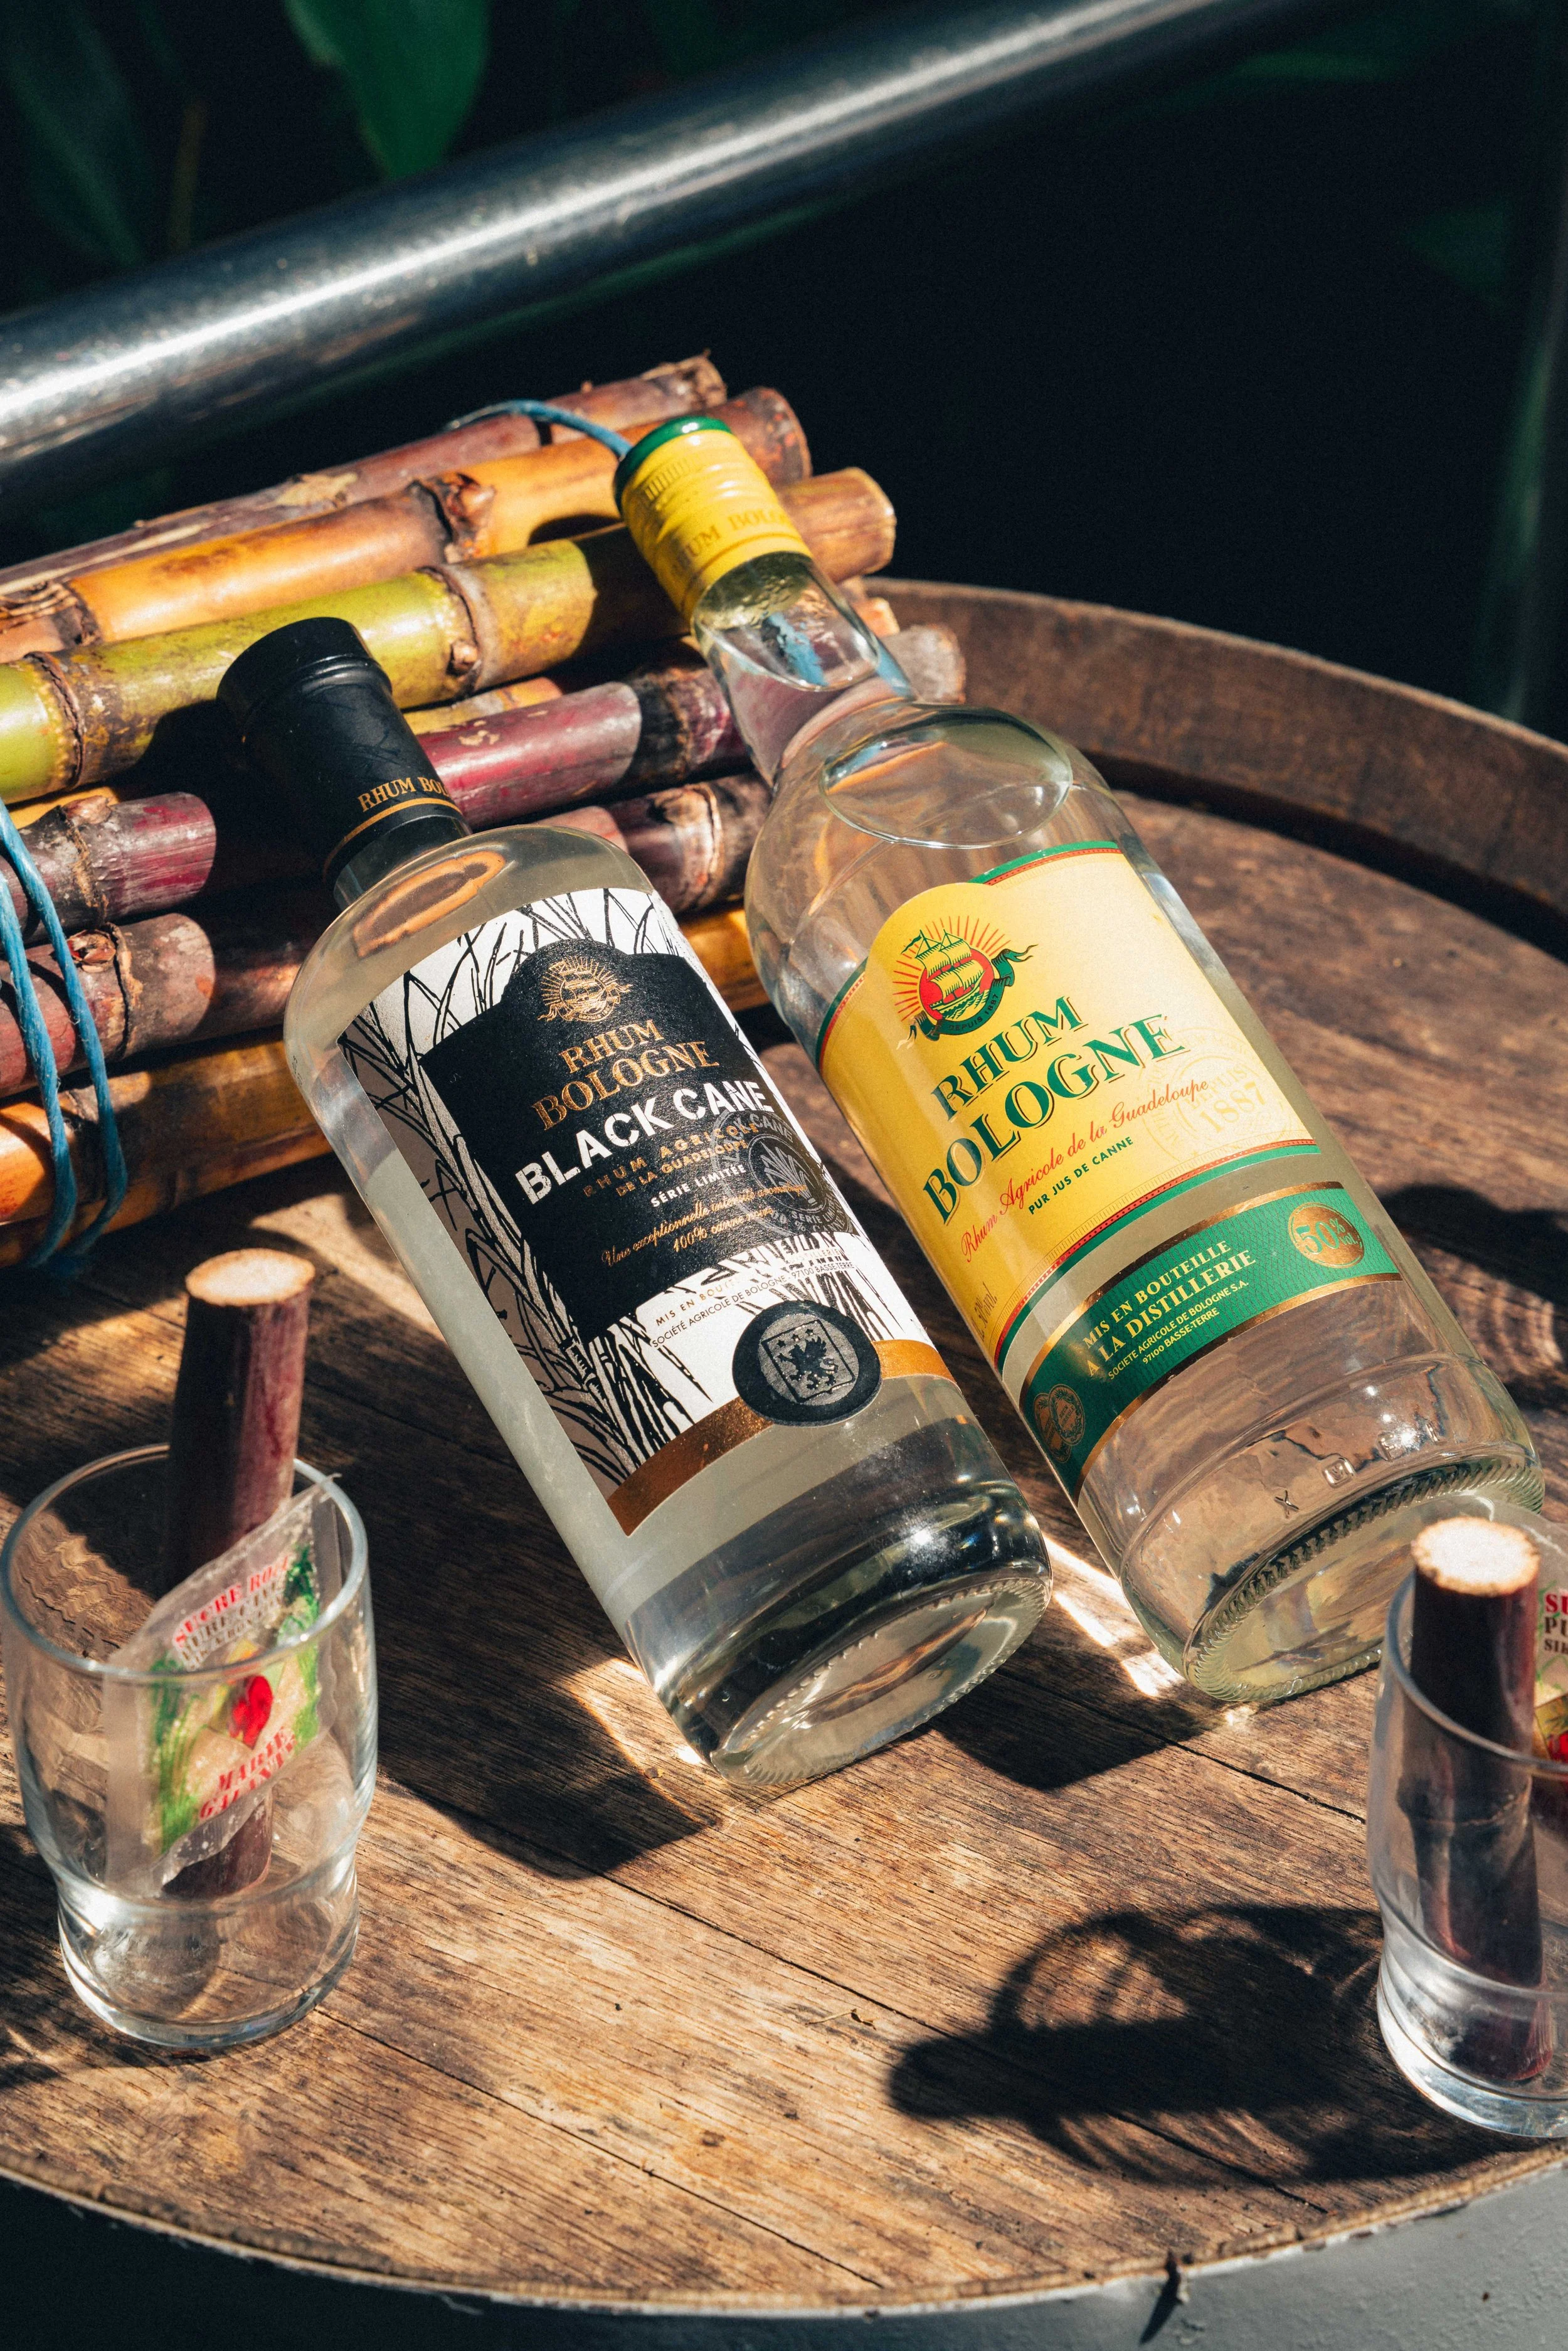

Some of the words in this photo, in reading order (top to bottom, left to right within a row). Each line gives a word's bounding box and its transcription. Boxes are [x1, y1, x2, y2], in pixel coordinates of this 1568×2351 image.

[358, 777, 416, 812] RHUM
[559, 1019, 665, 1074] RHUM
[948, 1016, 983, 1031] DEPUIS
[984, 993, 999, 1016] 1887
[532, 1040, 720, 1131] BOLOGNE
[931, 995, 1088, 1121] RHUM
[515, 1096, 675, 1205] BLACK
[673, 1080, 775, 1120] CANE
[922, 1014, 1190, 1224] BOLOGNE
[1199, 1080, 1266, 1133] 1887
[583, 1156, 647, 1197] RHUM
[660, 1122, 760, 1159] AGRICOLE
[616, 1181, 636, 1197] DE
[638, 1170, 659, 1186] LA
[661, 1139, 749, 1174] GUADELOUPE
[650, 1182, 691, 1207] SÉRIE
[695, 1164, 747, 1187] LIMITÉE
[960, 1214, 998, 1262] Rhum
[999, 1153, 1065, 1216] Agricole
[1066, 1134, 1087, 1159] de
[1088, 1120, 1108, 1144] la
[1110, 1078, 1209, 1130] Guadeloupe
[1027, 1193, 1050, 1216] PUR
[1052, 1175, 1073, 1196] JUS
[1074, 1162, 1091, 1180] DE
[1091, 1135, 1135, 1168] CANNE
[601, 1245, 631, 1267] Une
[672, 1225, 708, 1253] 100%
[652, 1321, 688, 1348] SOCIÉTÉ
[688, 1298, 732, 1327] AGRICOLE
[731, 1292, 744, 1303] DE
[744, 1275, 788, 1297] BOLOGNE
[792, 1267, 815, 1280] 97100
[815, 1261, 855, 1273] BASSE-TERRE
[655, 1309, 676, 1327] MIS
[680, 1298, 696, 1312] EN
[1083, 1320, 1110, 1349] MIS
[1111, 1300, 1133, 1324] EN
[1134, 1240, 1231, 1305] BOUTEILLE
[1098, 1335, 1126, 1362] LA
[1125, 1250, 1256, 1339] DISTILLERIE
[1108, 1349, 1139, 1380] SOCIETE
[1138, 1320, 1177, 1354] AGRICOLE
[1175, 1312, 1190, 1325] DE
[1189, 1287, 1232, 1317] BOLOGNE
[1230, 1280, 1249, 1293] S.A.
[1142, 1345, 1165, 1364] 97100
[1163, 1307, 1220, 1347] BASSE-TERRE
